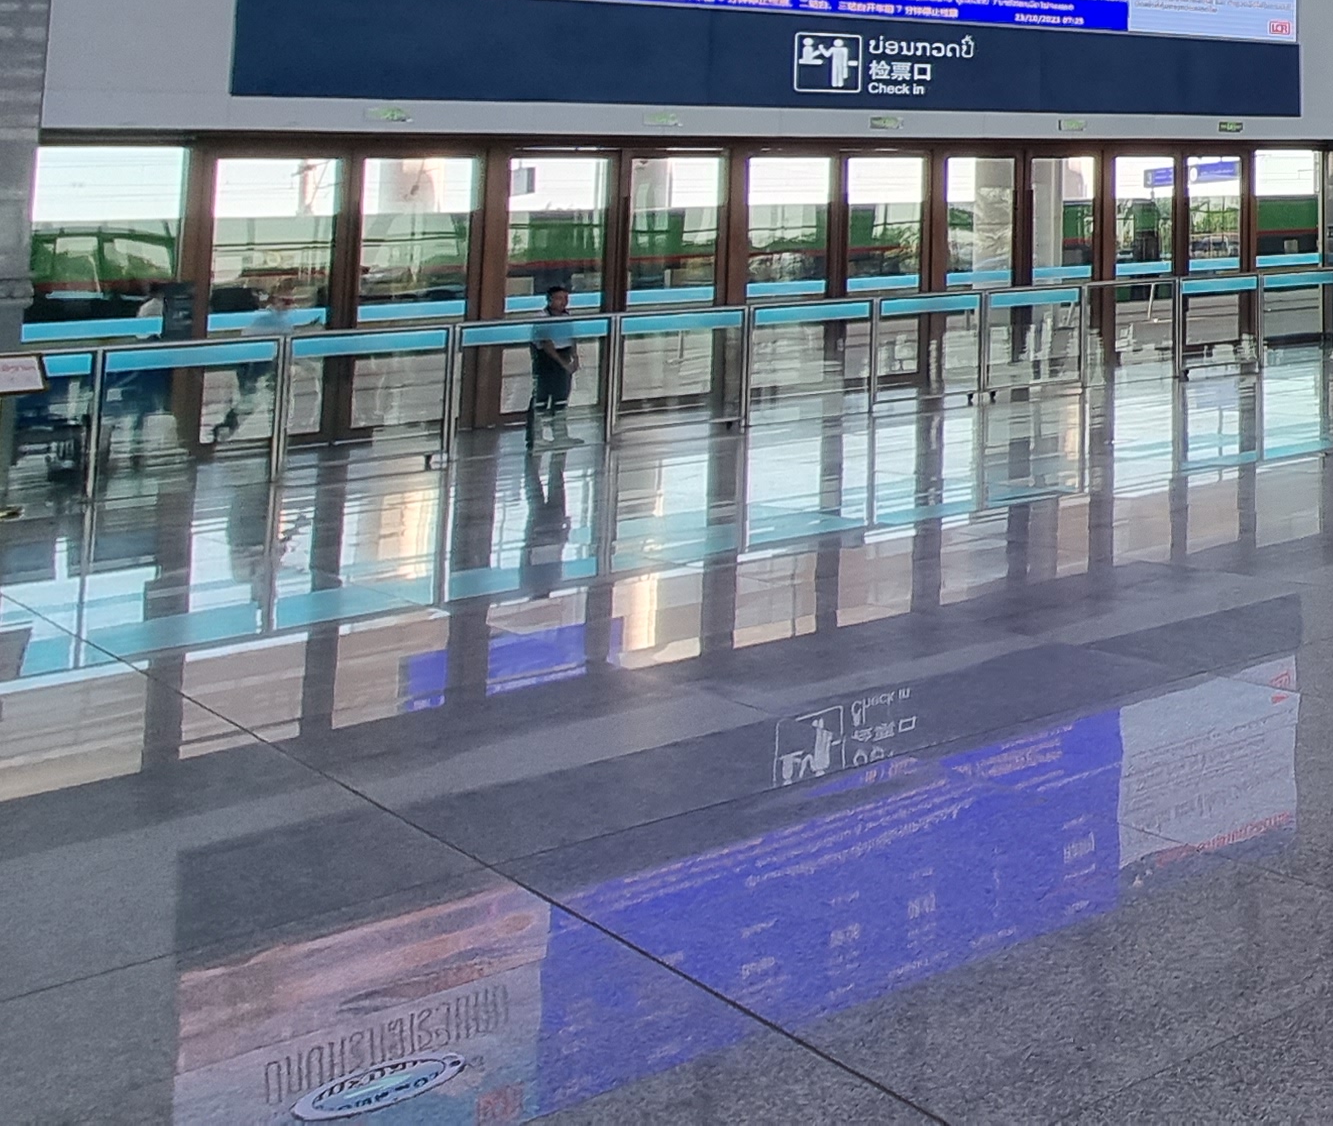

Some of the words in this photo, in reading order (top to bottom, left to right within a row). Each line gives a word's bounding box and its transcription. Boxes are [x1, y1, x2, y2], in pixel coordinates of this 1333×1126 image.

[868, 35, 975, 59] ບ່ອນກວດປີ້
[868, 60, 932, 81] 检票口
[867, 82, 910, 95] Check
[912, 83, 926, 95] in
